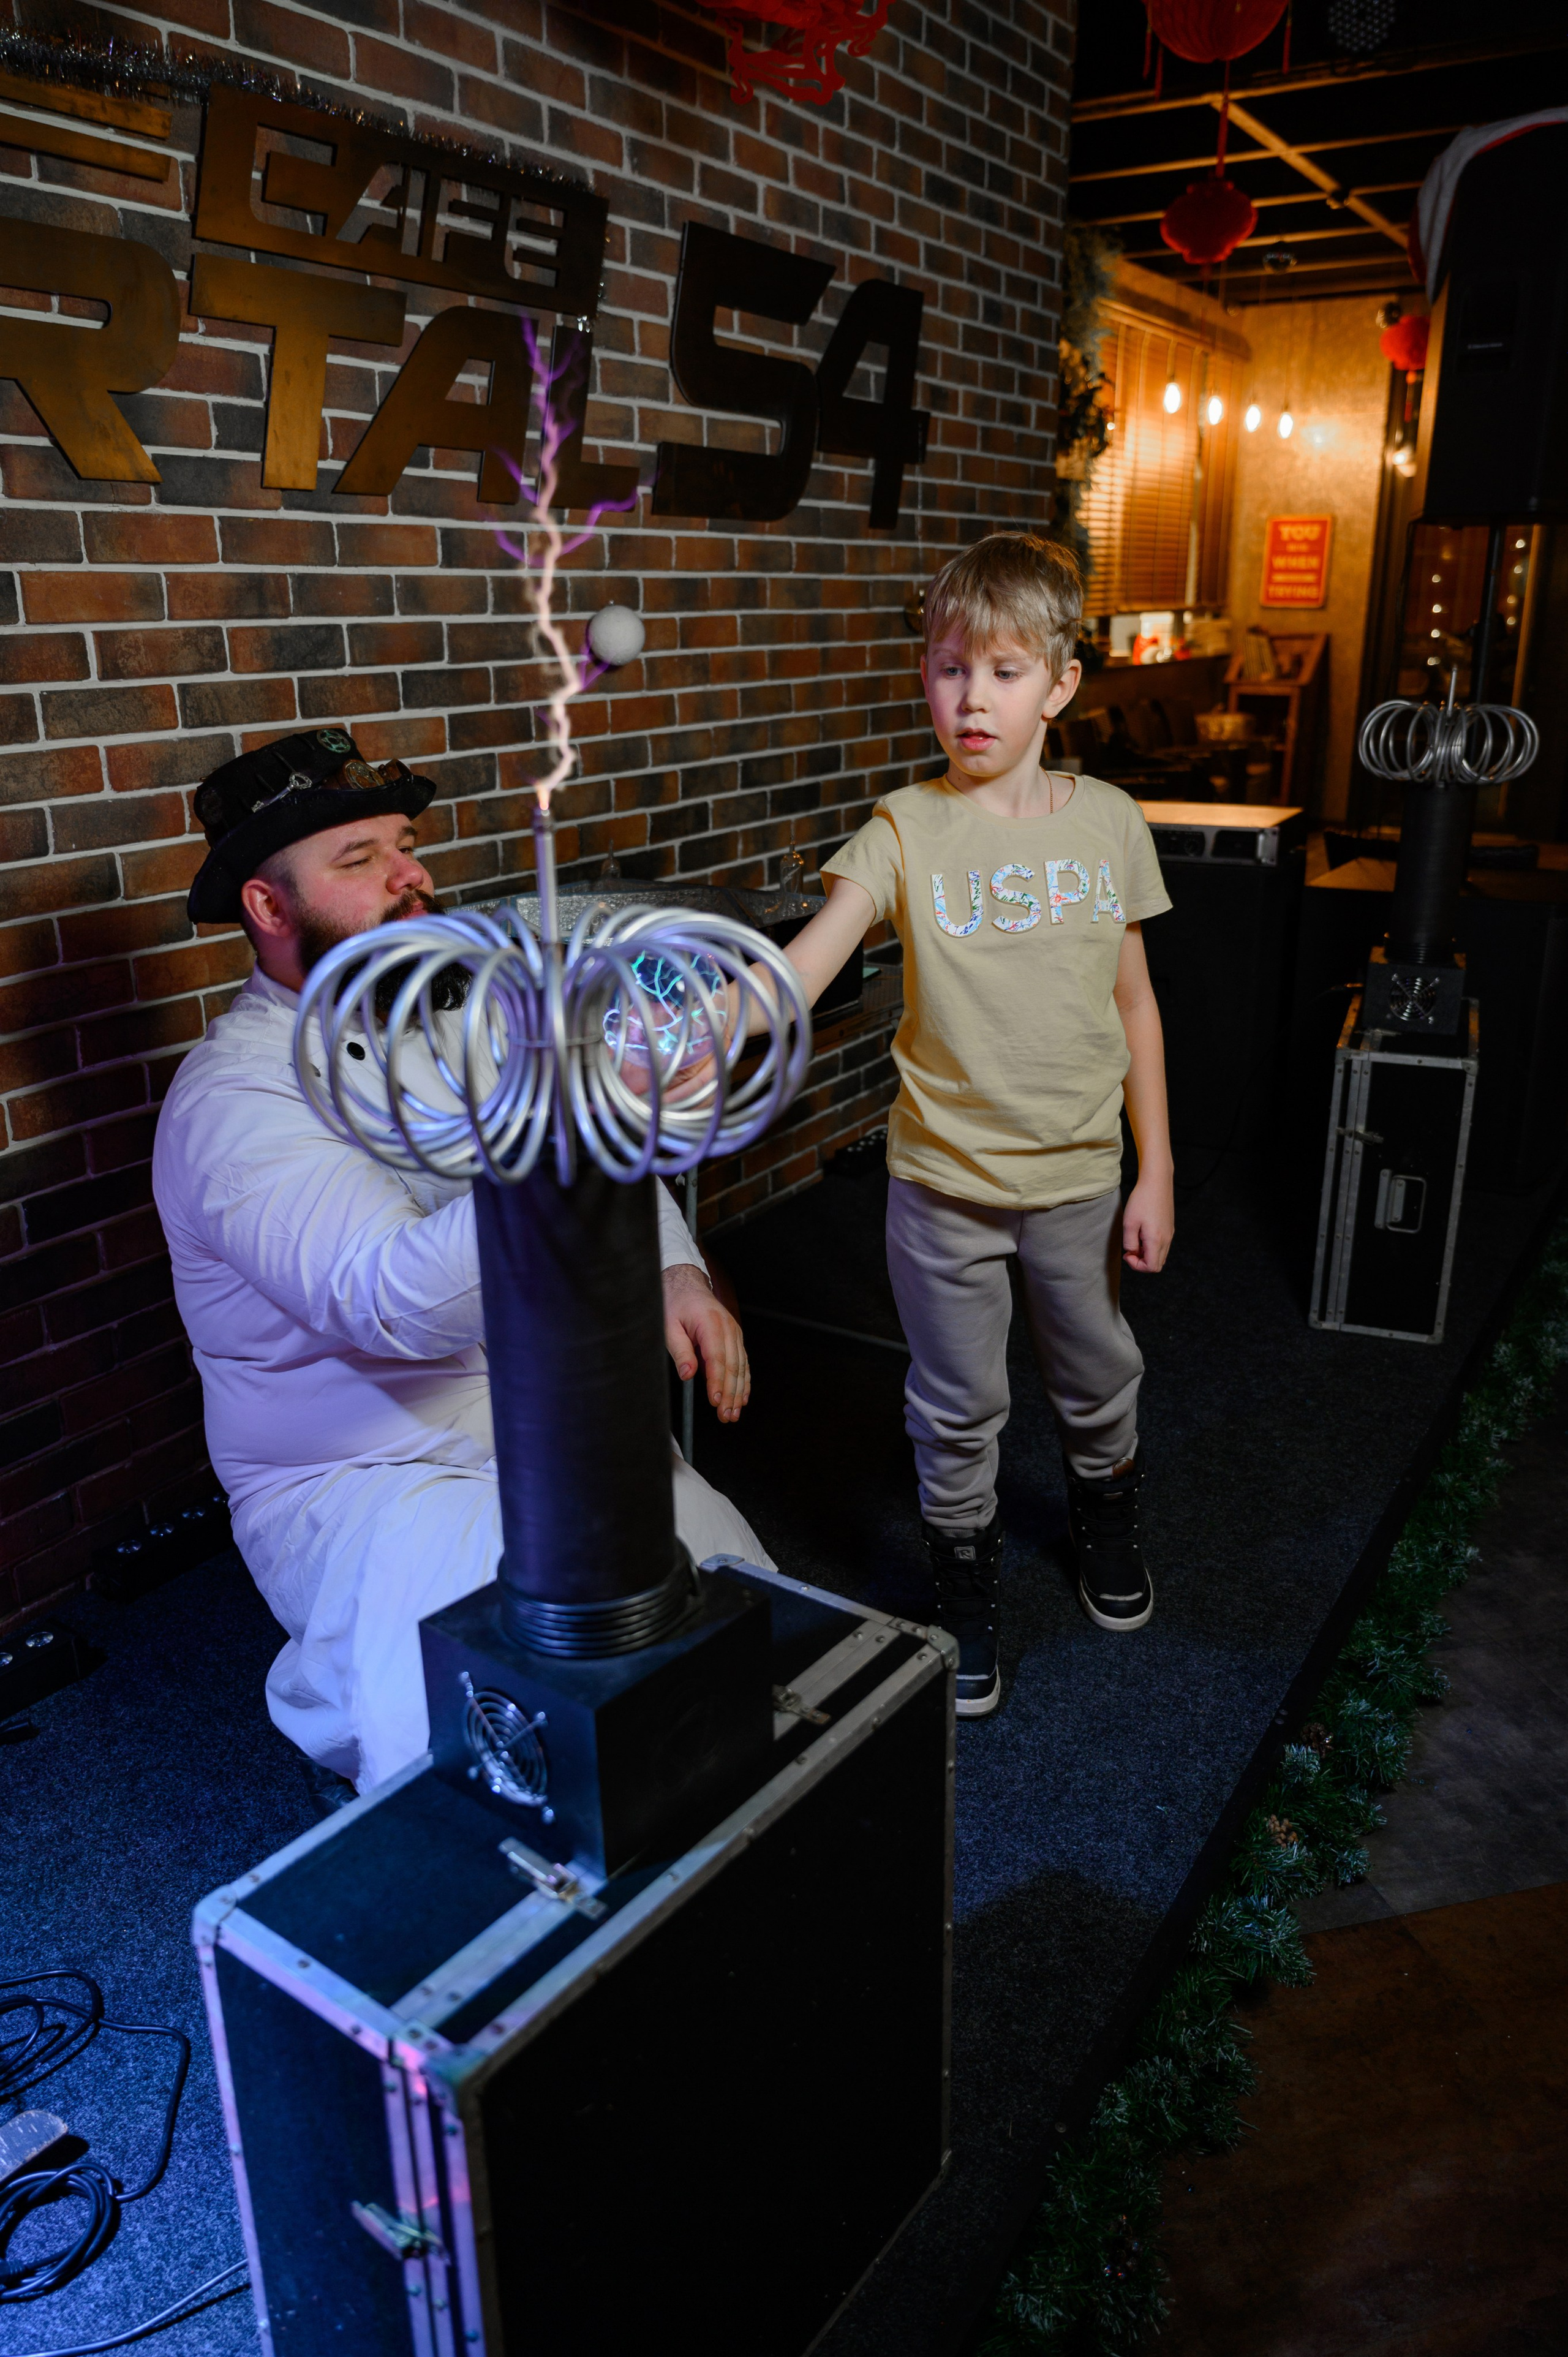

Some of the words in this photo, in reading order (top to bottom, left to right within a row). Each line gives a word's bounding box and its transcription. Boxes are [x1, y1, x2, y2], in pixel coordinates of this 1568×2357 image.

[249, 123, 568, 288] CAFE
[651, 221, 930, 530] 54
[1272, 556, 1320, 570] WHEN
[1278, 524, 1321, 541] YOU
[930, 859, 1126, 938] USPA
